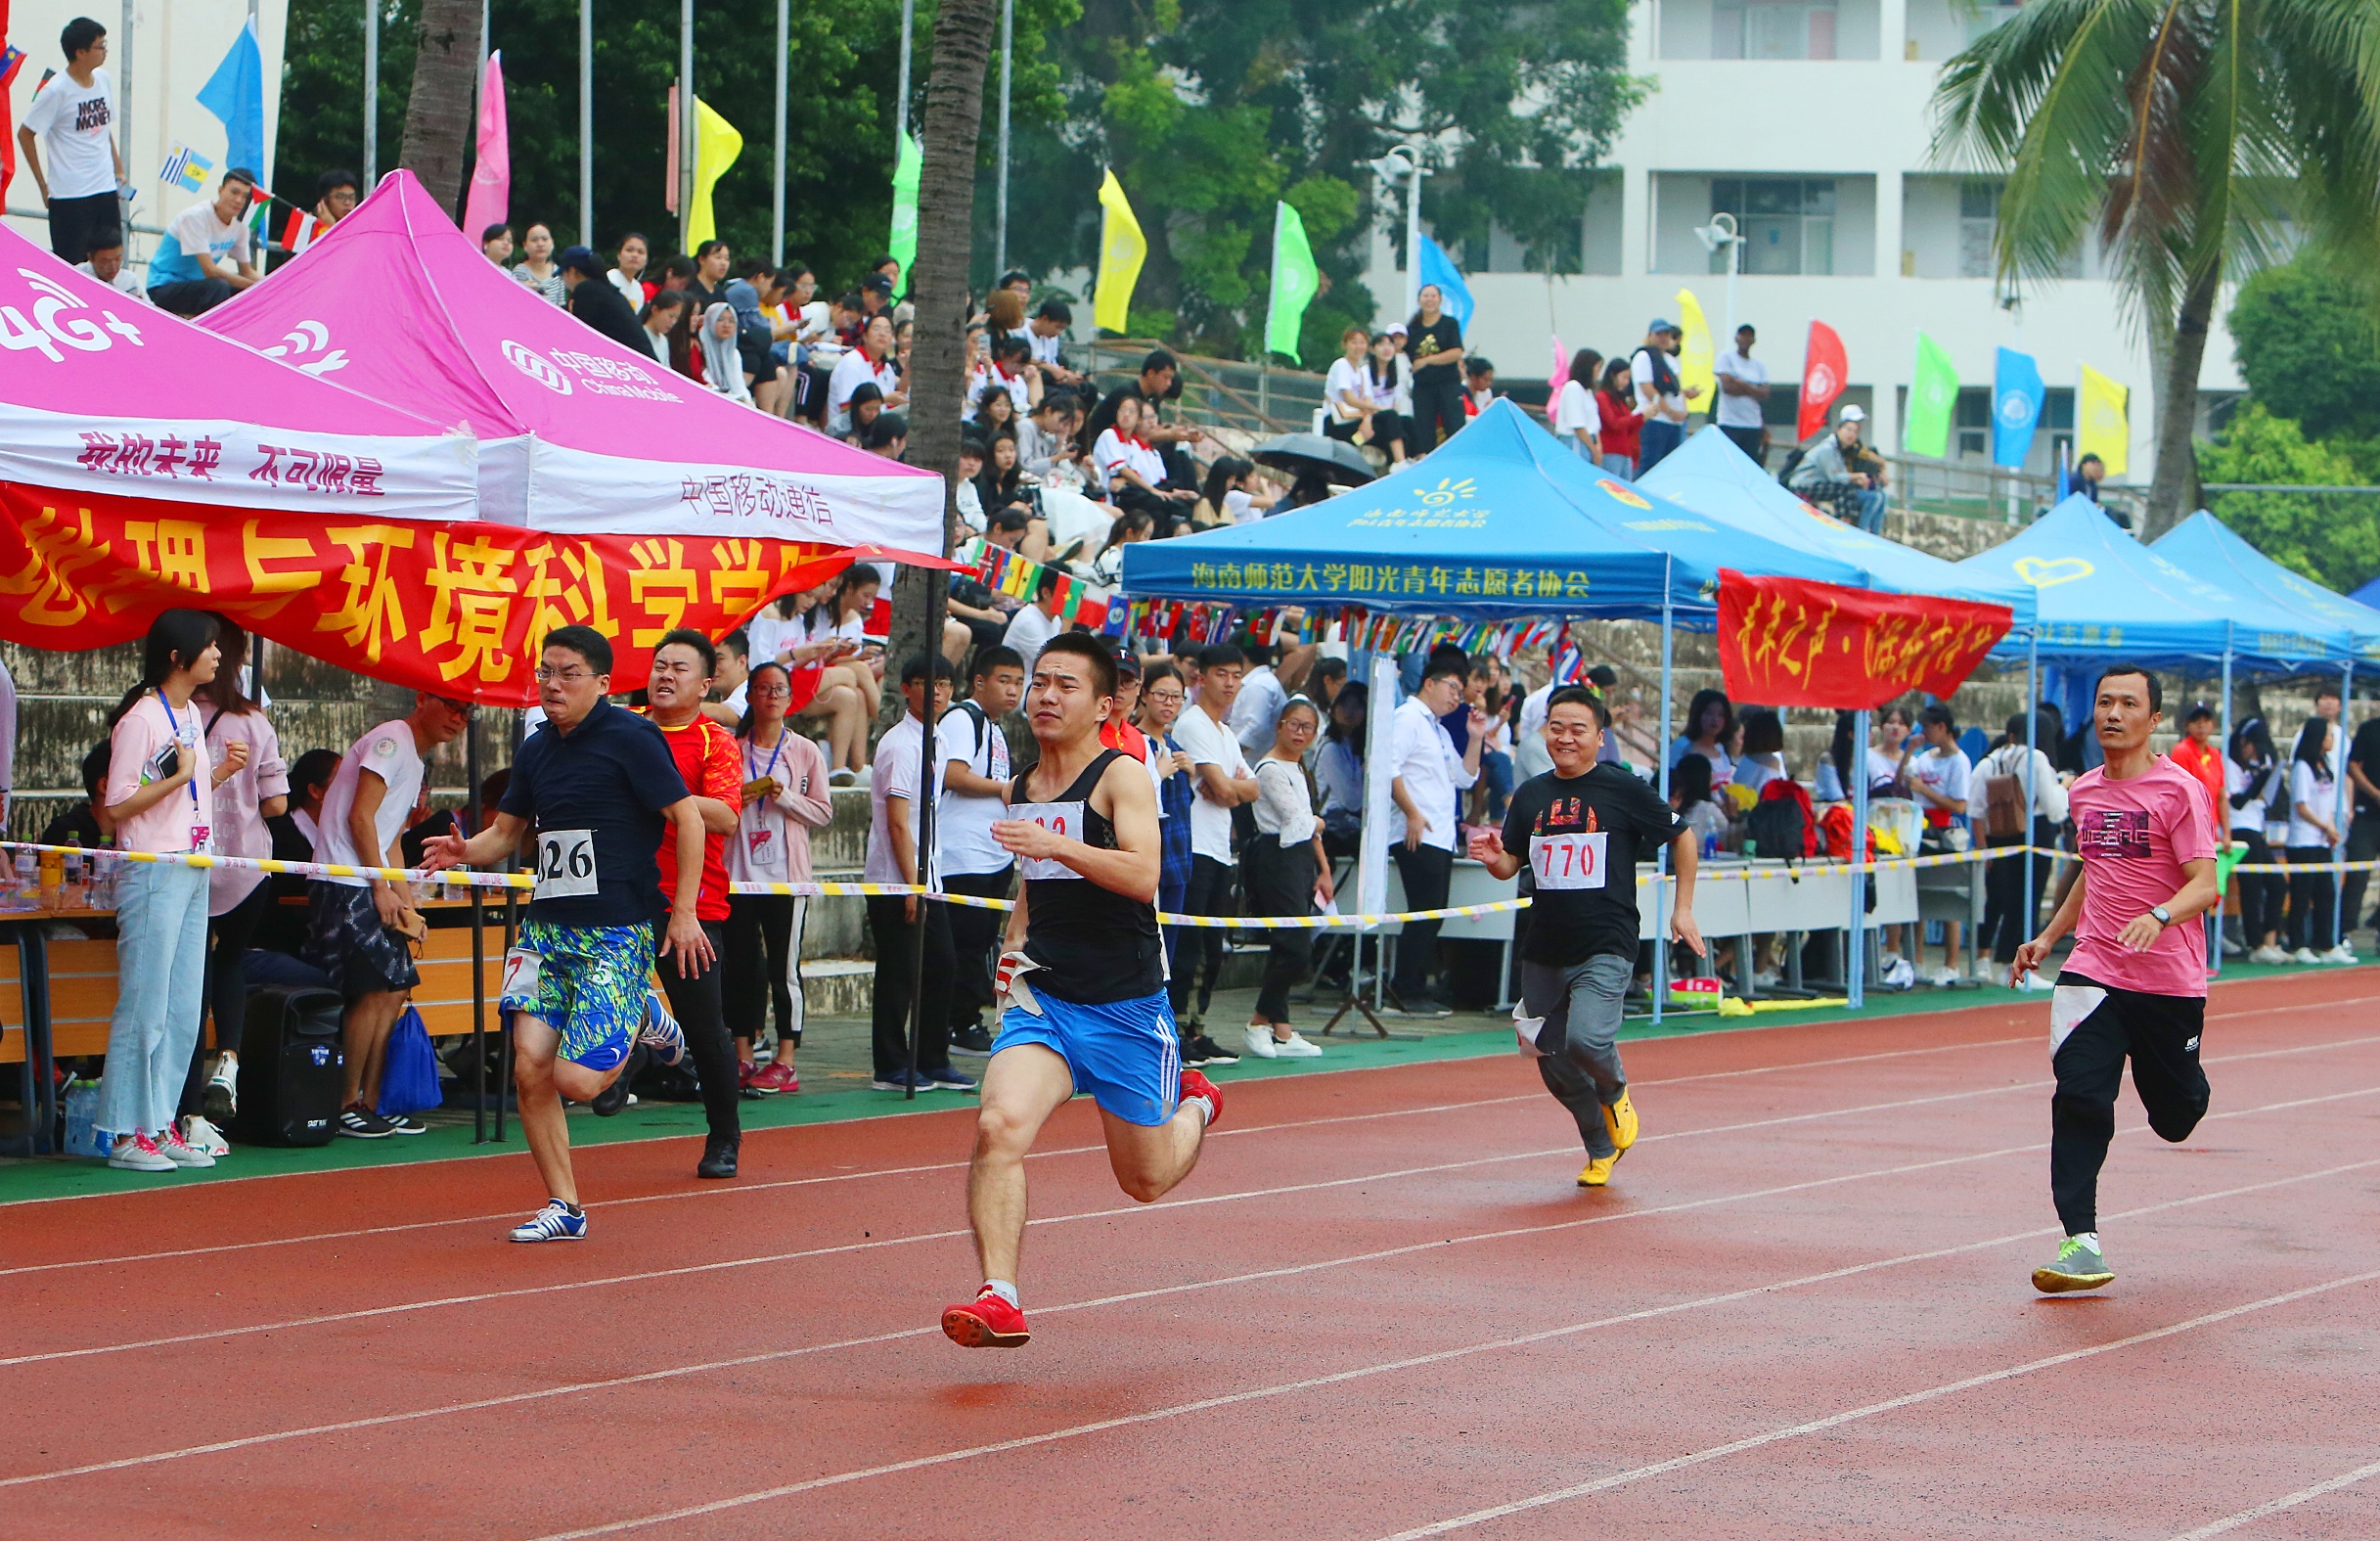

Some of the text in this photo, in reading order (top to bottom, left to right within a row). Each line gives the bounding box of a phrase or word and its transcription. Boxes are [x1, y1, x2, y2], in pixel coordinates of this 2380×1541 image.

[79, 97, 107, 115] MORE
[549, 347, 658, 385] 中国移动
[76, 431, 385, 496] 我的未来 不可限量
[680, 474, 833, 526] 中国移动通信
[1191, 561, 1591, 599] 海南师范大学阳光青年志愿者协会
[1542, 843, 1594, 877] 770
